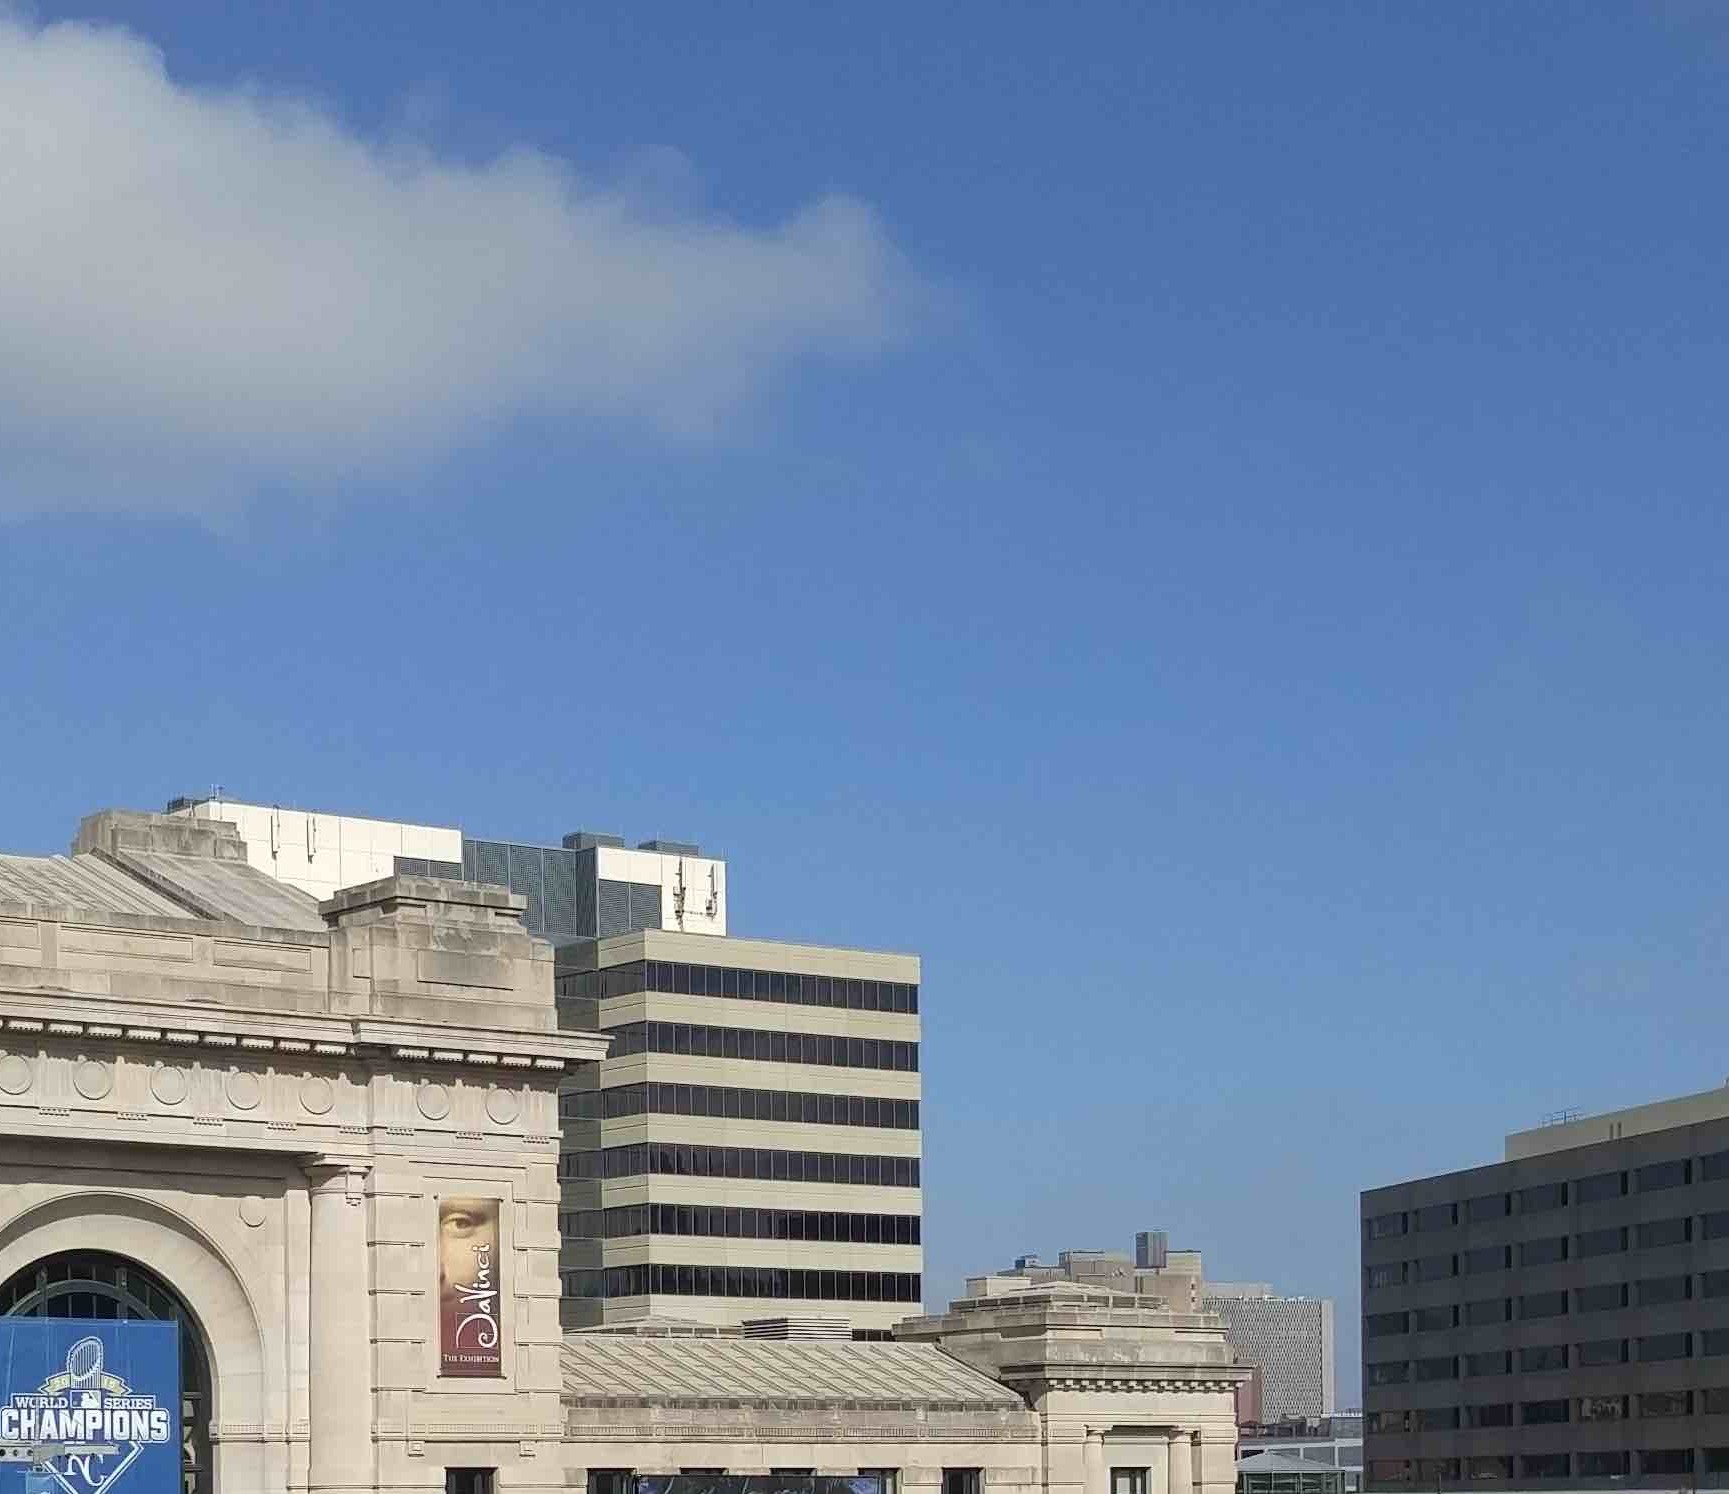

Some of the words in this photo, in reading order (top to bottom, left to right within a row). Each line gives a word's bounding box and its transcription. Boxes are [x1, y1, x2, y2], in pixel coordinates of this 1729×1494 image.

[14, 1396, 68, 1409] WORLD
[104, 1397, 153, 1409] SERIES
[1, 1409, 169, 1441] CHAMPIONS
